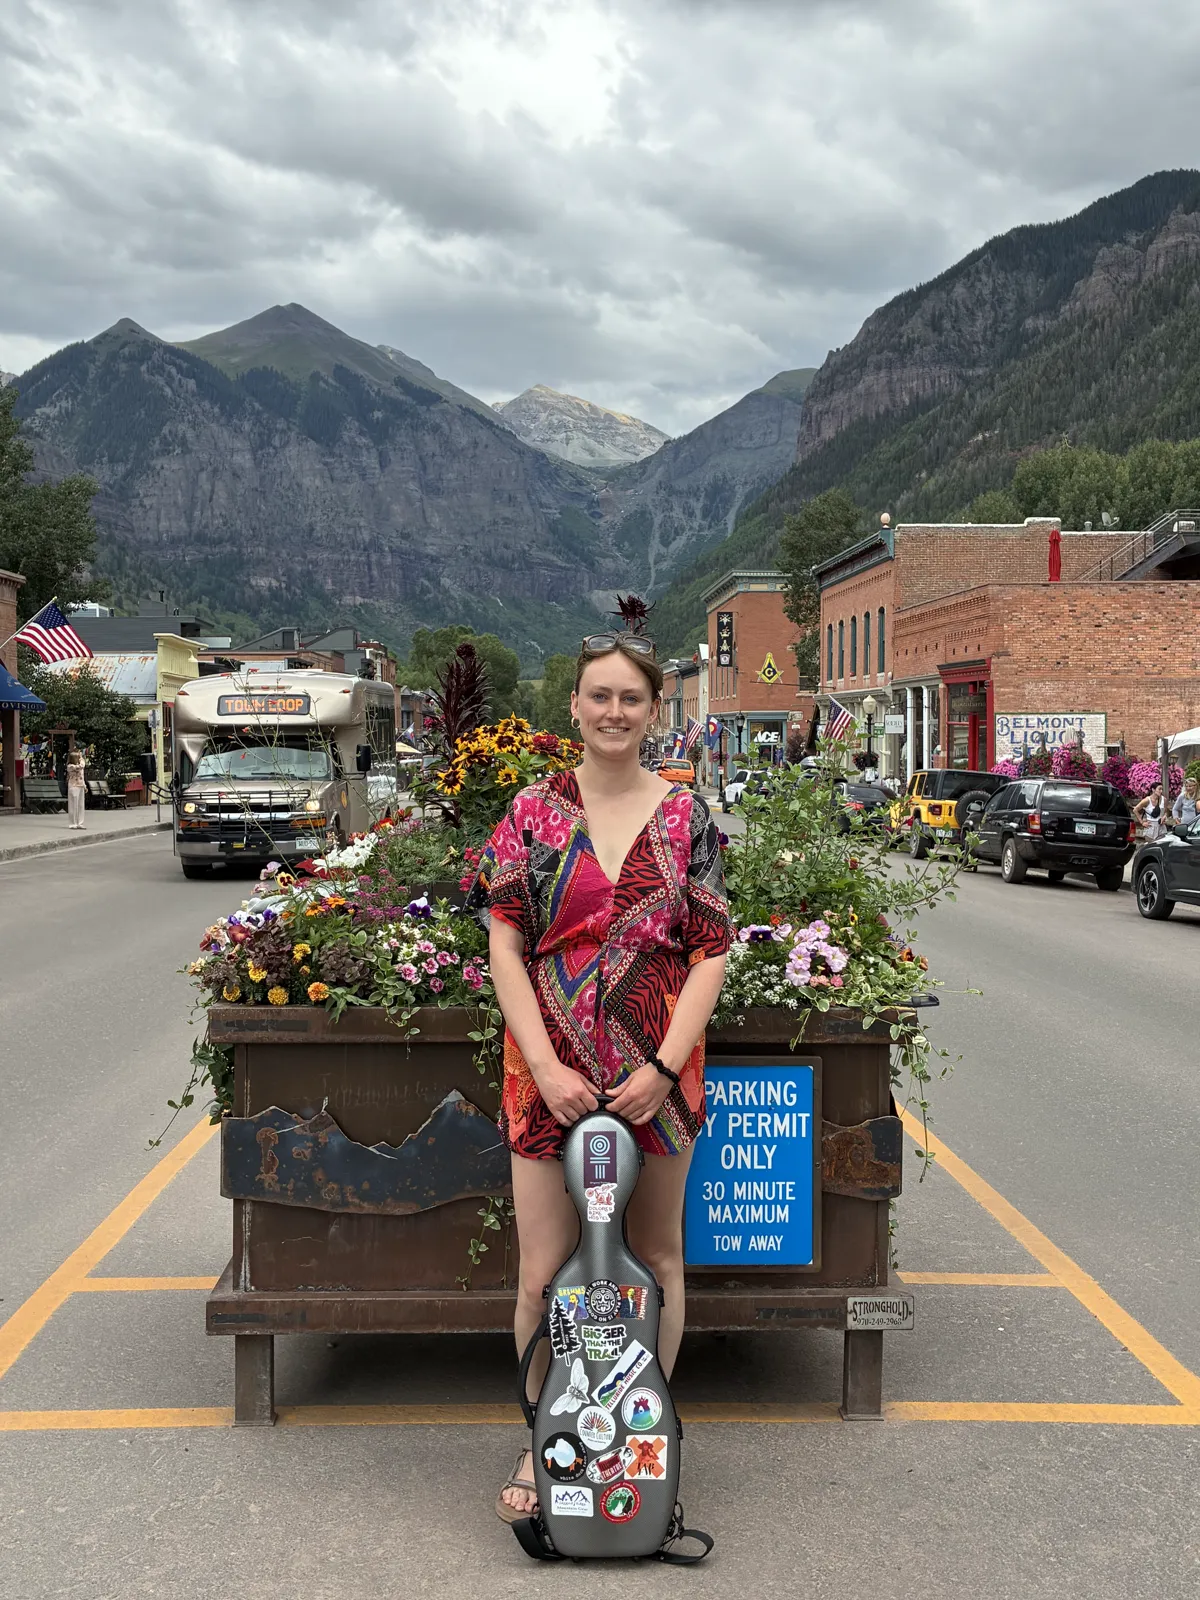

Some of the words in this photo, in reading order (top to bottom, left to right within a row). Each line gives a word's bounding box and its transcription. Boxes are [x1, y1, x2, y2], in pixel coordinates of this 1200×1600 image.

[225, 699, 265, 713] TOWN
[268, 698, 304, 712] LOOP
[997, 716, 1086, 736] BELMONT
[754, 731, 779, 743] ACE
[704, 1080, 797, 1107] PARKING
[697, 1113, 718, 1138] Y
[728, 1113, 811, 1138] PERMIT
[720, 1144, 778, 1170] ONLY
[702, 1181, 726, 1201] 30
[733, 1181, 796, 1201] MINUTE
[708, 1204, 789, 1224] MAXIMUM
[713, 1235, 743, 1252] TOW
[748, 1235, 784, 1252] AWAY
[852, 1300, 909, 1321] STRONGHOLD
[586, 1339, 607, 1347] THAN
[607, 1338, 621, 1347] THE
[624, 1369, 637, 1385] MUSIC
